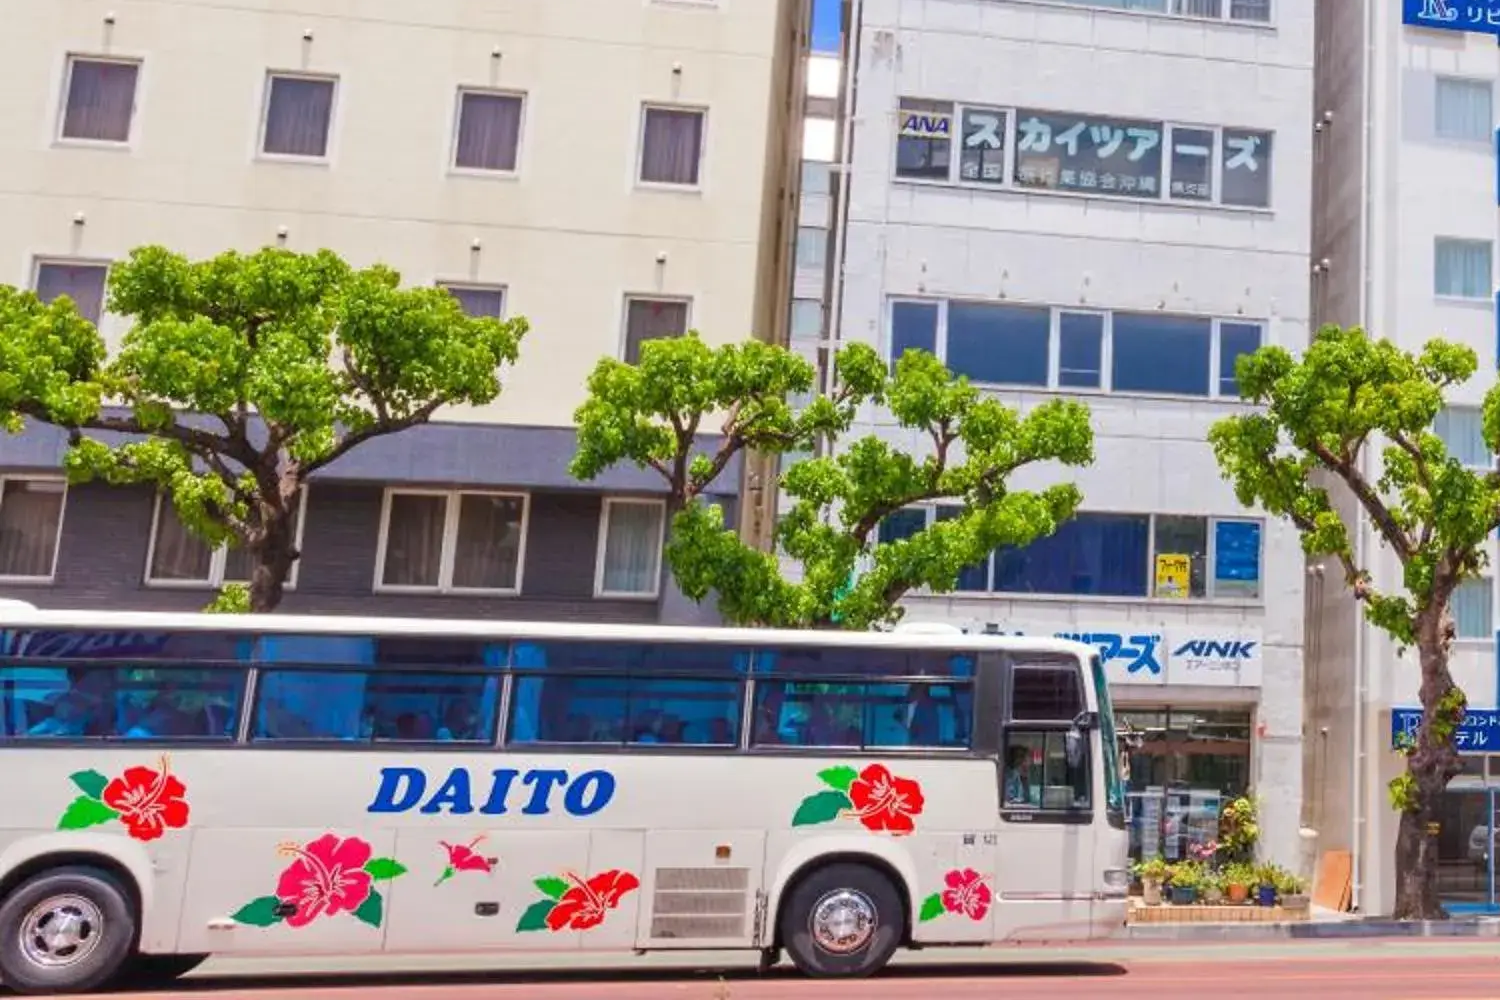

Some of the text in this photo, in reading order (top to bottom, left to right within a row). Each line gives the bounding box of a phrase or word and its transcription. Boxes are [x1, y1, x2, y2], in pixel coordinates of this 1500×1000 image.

[901, 113, 1262, 172] ANA スカイツアーズ
[1173, 639, 1257, 658] ANK
[367, 767, 617, 817] DAITO
